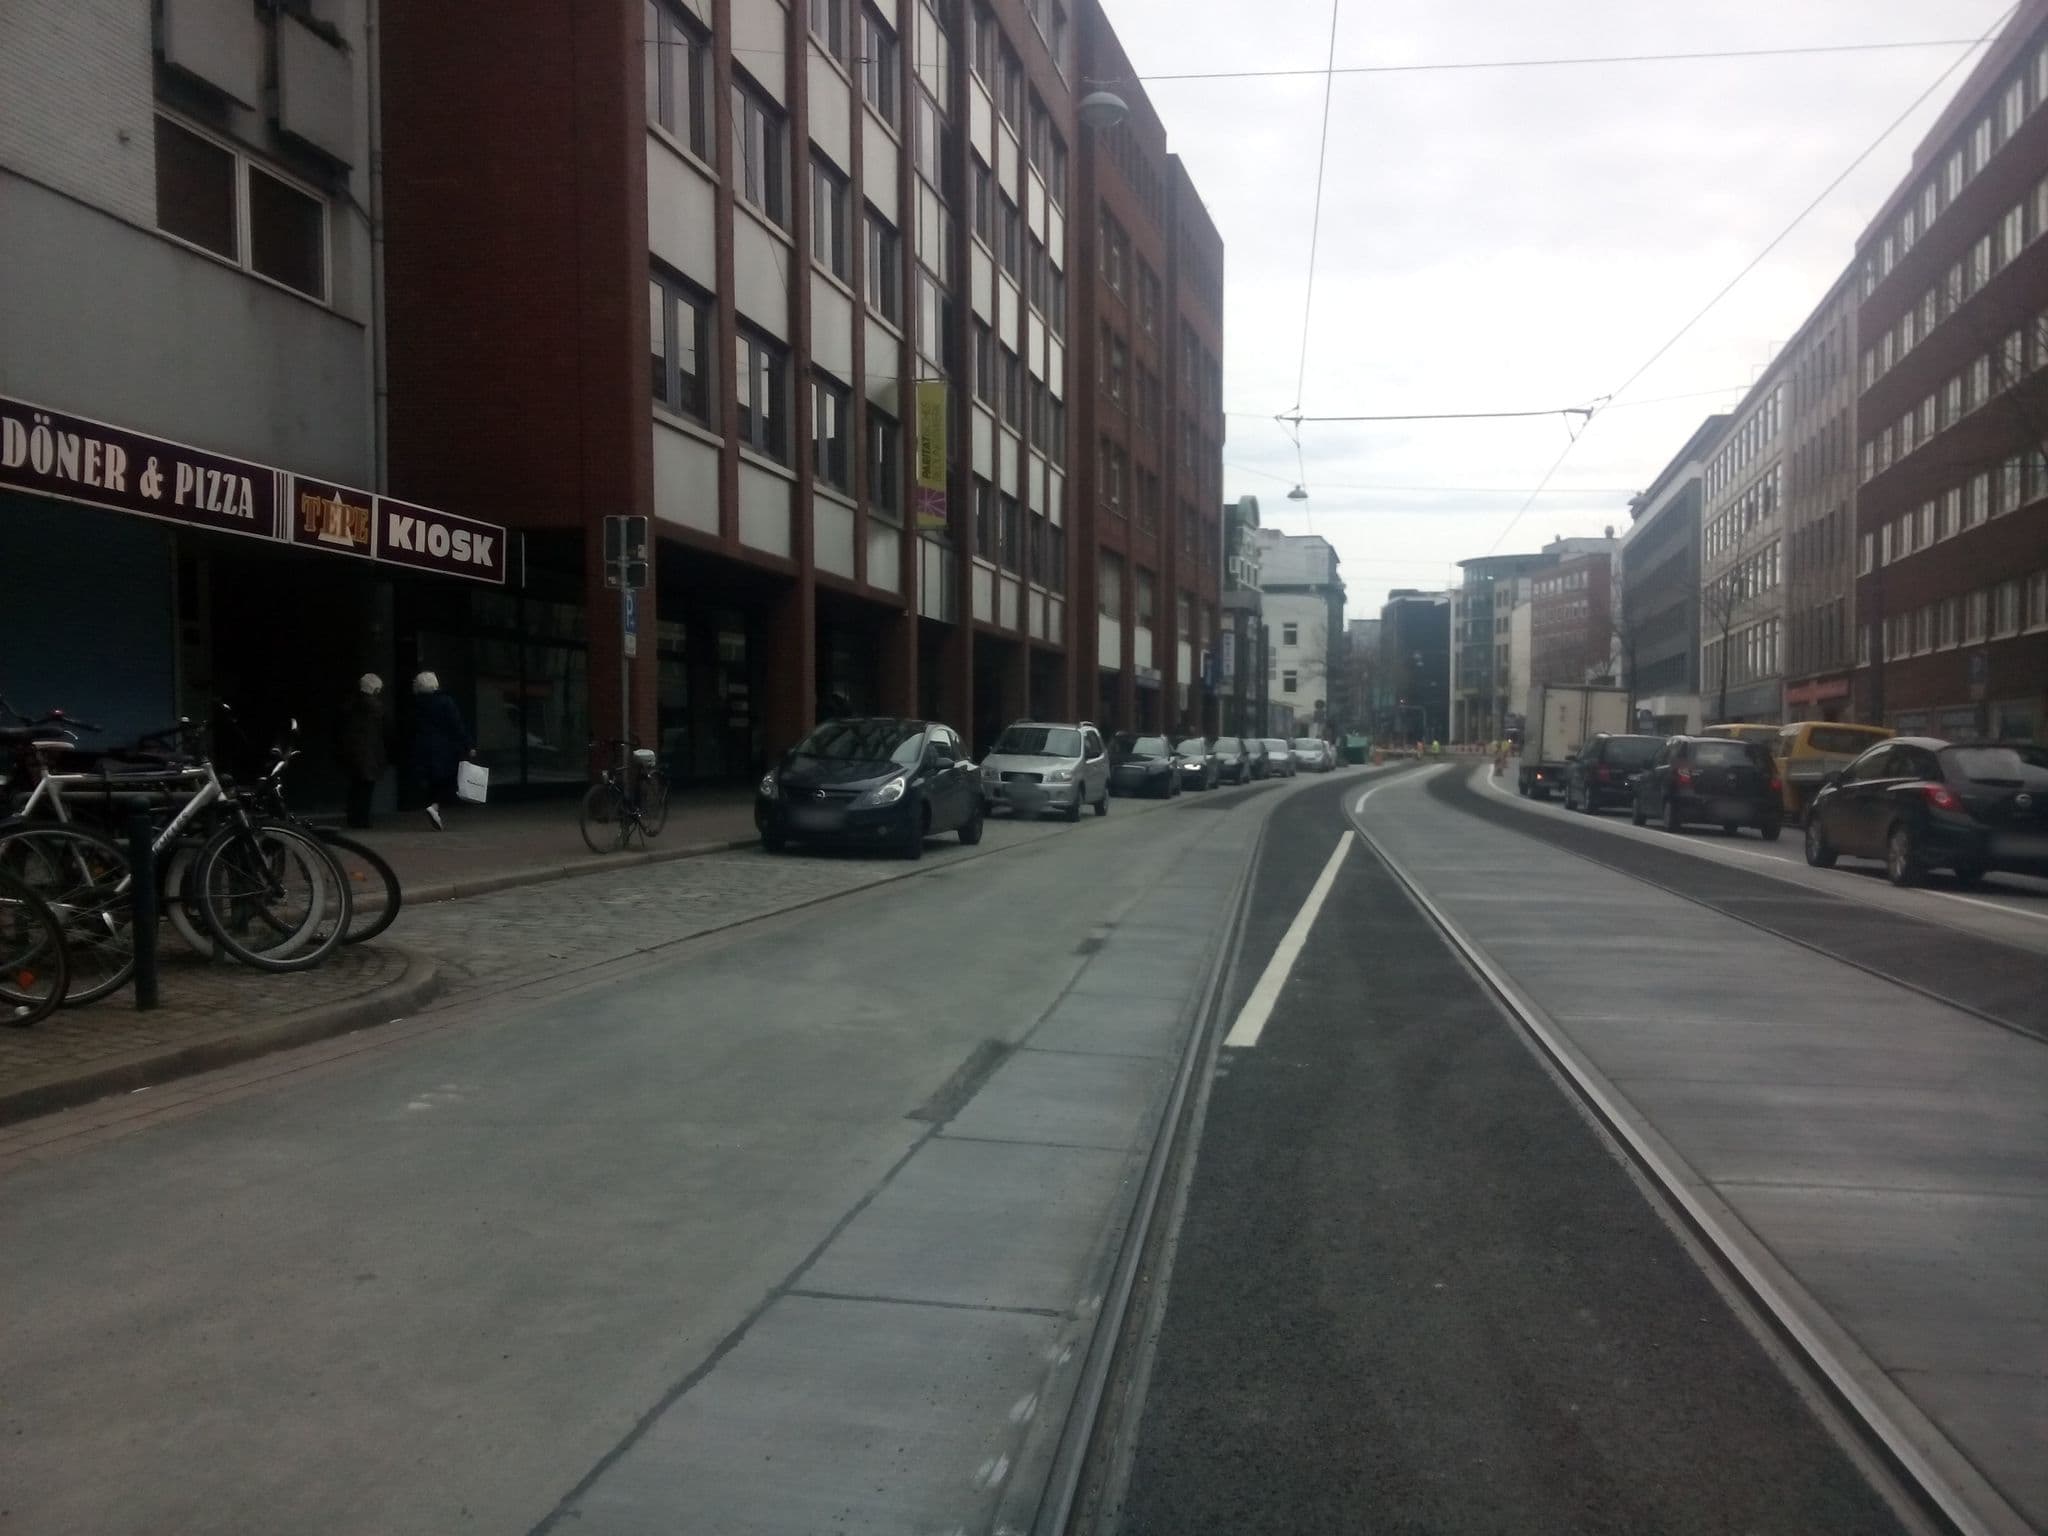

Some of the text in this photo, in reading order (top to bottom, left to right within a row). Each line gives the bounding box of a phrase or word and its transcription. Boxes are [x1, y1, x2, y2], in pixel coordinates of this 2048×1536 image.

[1, 413, 254, 519] DÖNER & PIZZA
[389, 512, 494, 567] KIOSK
